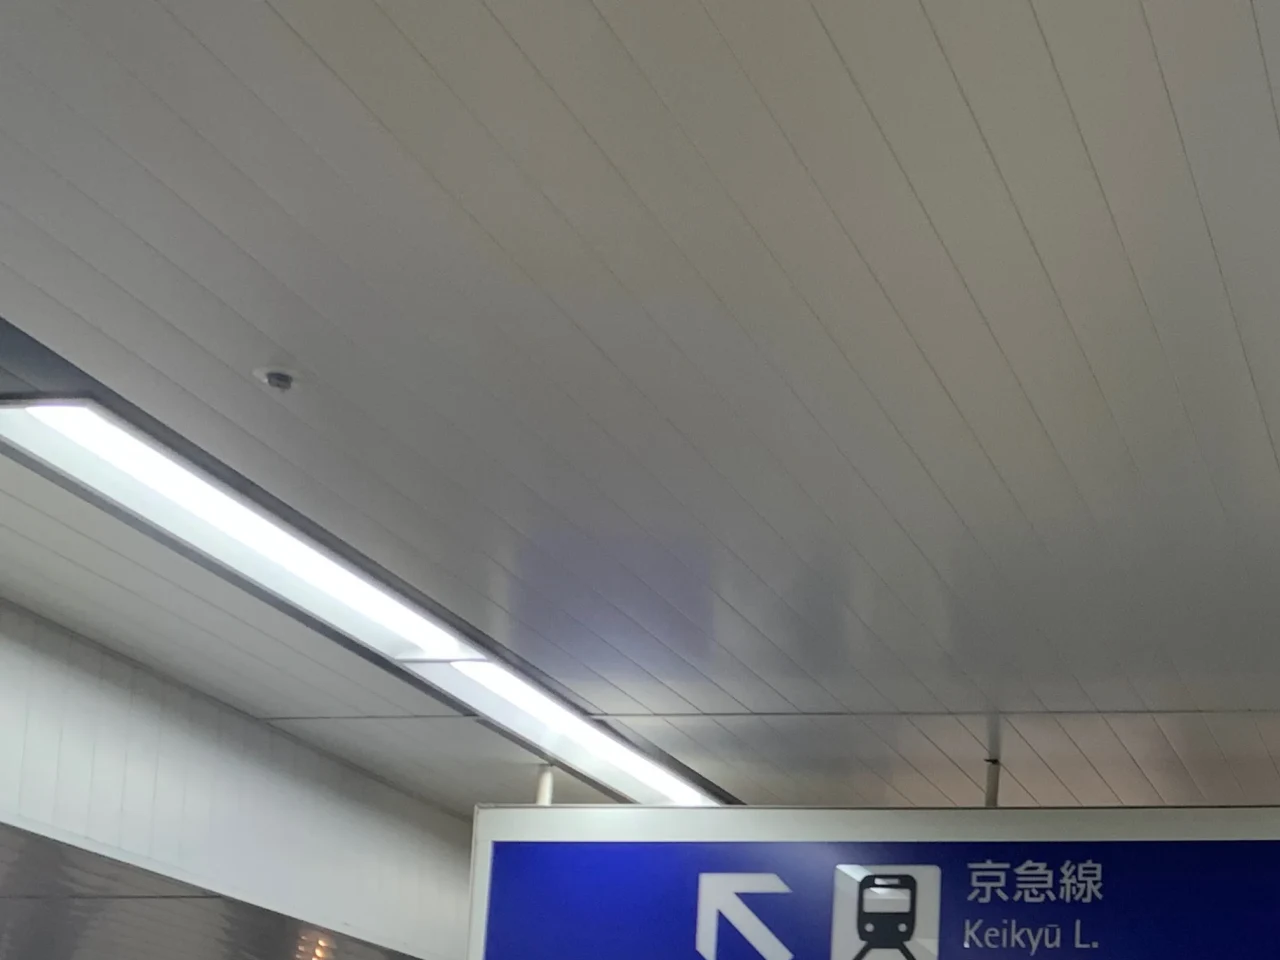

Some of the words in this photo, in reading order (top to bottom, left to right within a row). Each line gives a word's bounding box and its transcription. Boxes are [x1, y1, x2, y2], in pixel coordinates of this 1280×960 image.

[967, 859, 1103, 903] 京急線
[963, 919, 1061, 956] Keikyū
[1074, 919, 1099, 949] L.
